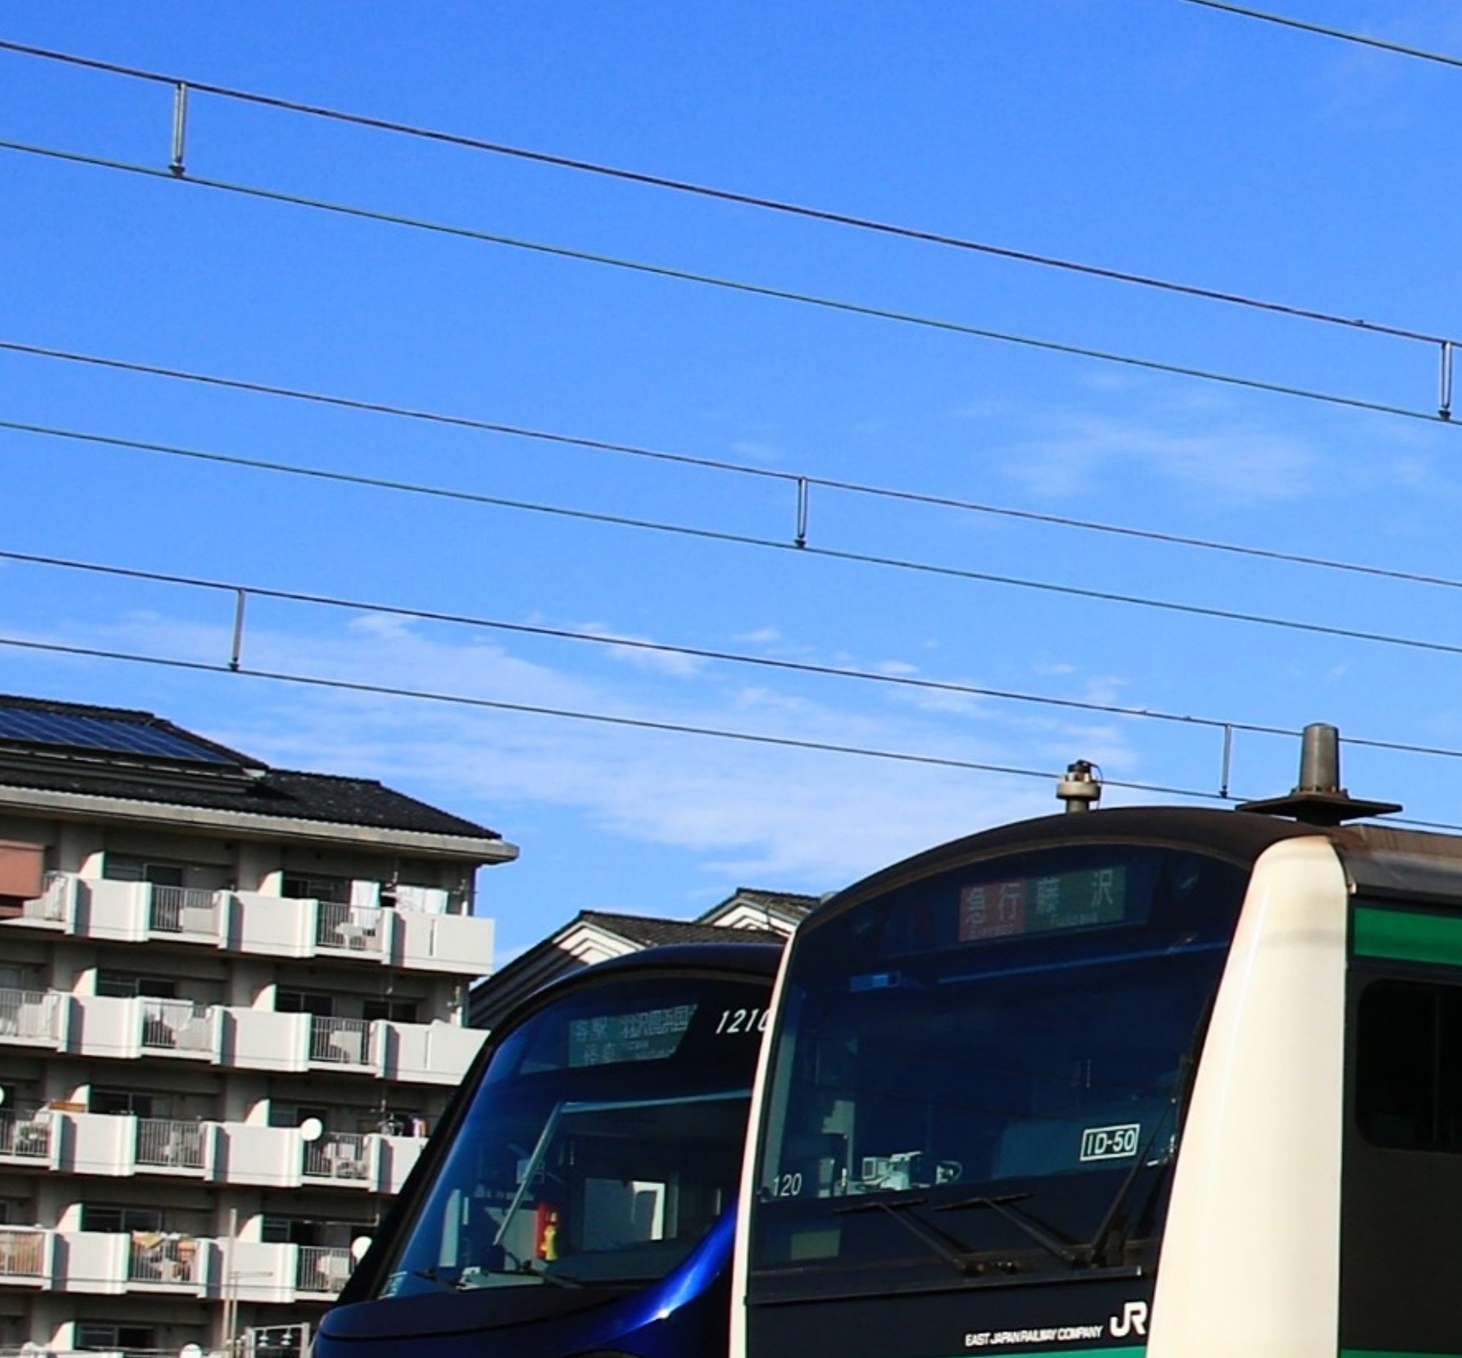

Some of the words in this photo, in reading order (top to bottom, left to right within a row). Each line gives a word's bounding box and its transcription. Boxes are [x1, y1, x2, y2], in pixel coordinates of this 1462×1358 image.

[1087, 1128, 1136, 1155] ID-50
[773, 1172, 803, 1197] 120
[965, 1333, 991, 1347] EAST
[990, 1330, 1021, 1345] JAPAN
[1056, 1325, 1105, 1341] COMPANY
[1109, 1301, 1148, 1338] JR
